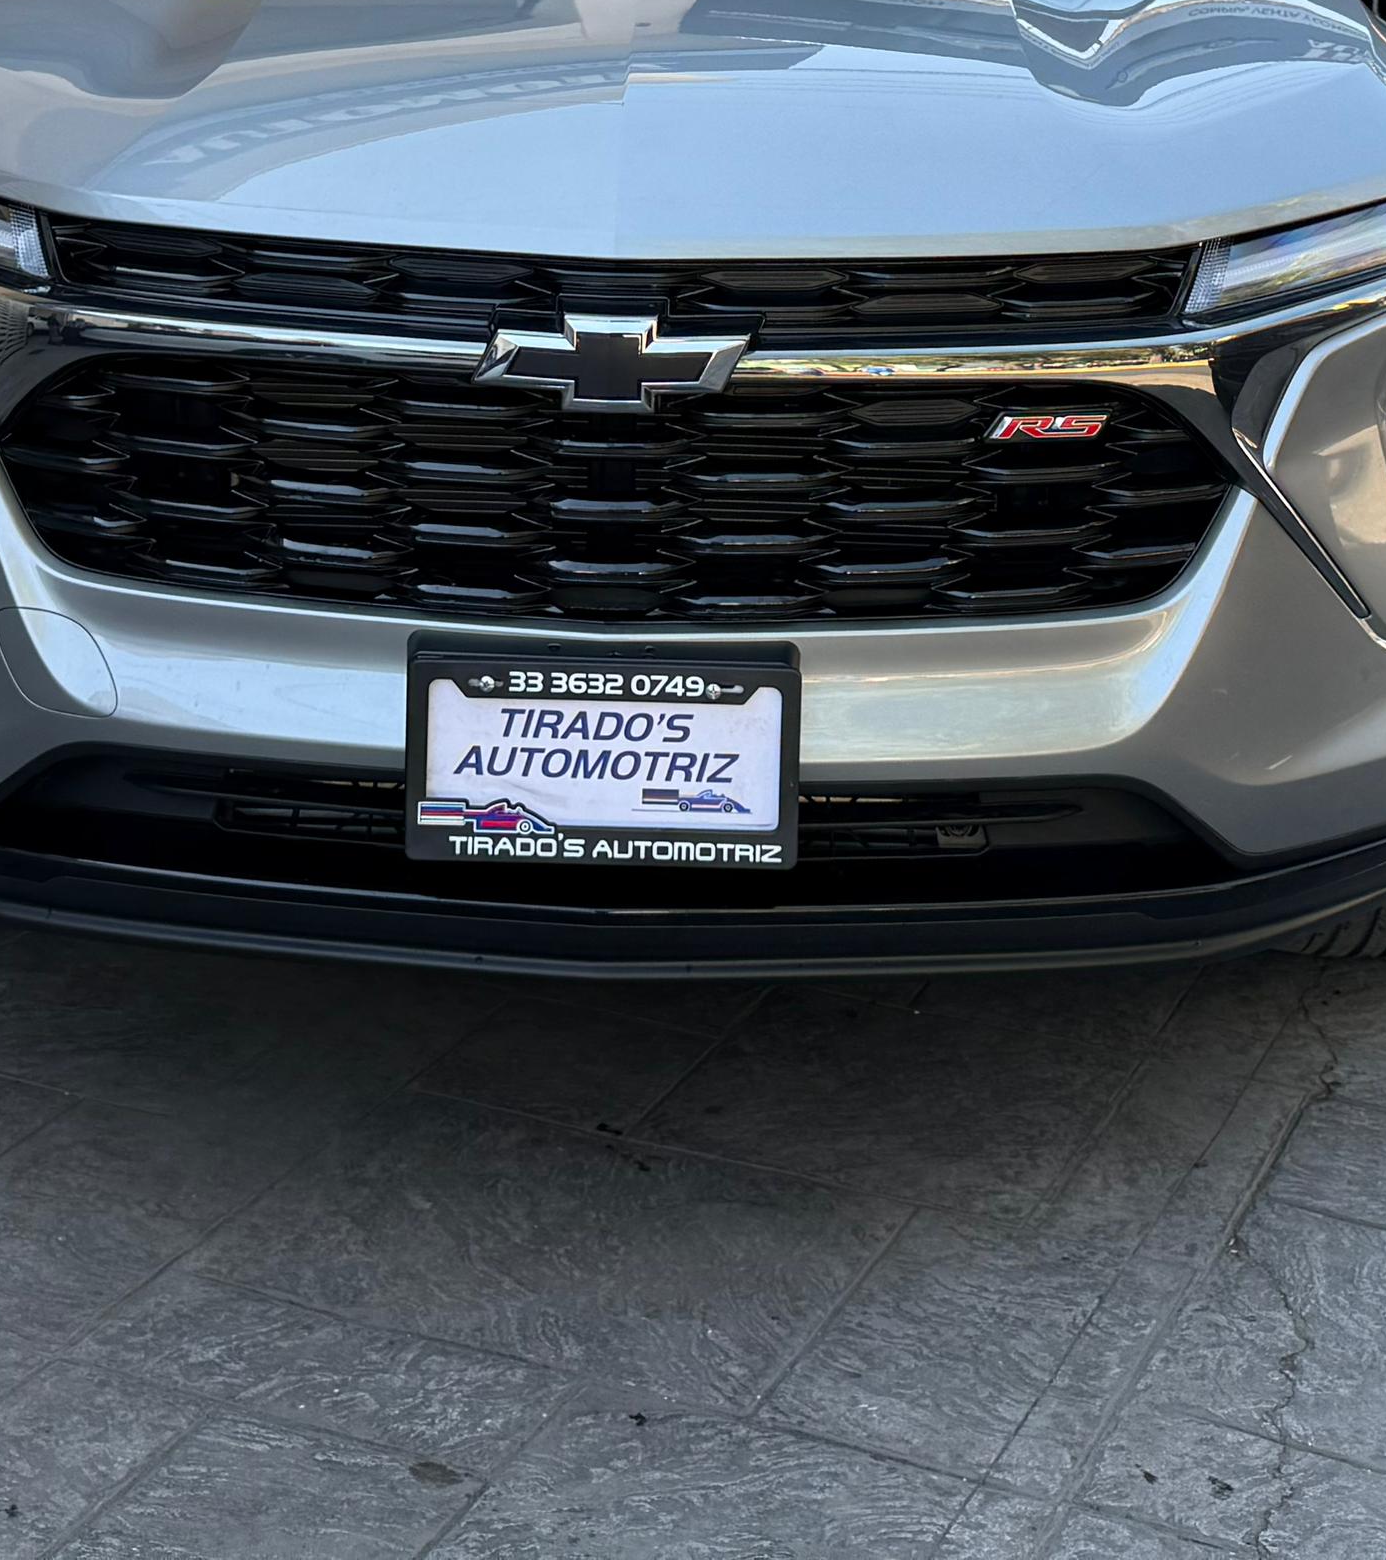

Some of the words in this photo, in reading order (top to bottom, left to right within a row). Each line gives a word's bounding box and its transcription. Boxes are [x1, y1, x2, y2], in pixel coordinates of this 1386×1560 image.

[990, 415, 1108, 439] RS
[508, 671, 544, 693] 33
[550, 672, 624, 695] 3632
[630, 674, 704, 698] 0749
[501, 707, 695, 743] TIRADO'S
[454, 744, 740, 784] AUTOMOTRIZ
[449, 833, 585, 859] TIRADO'S
[592, 838, 782, 864] AUTOMOTRIZ
